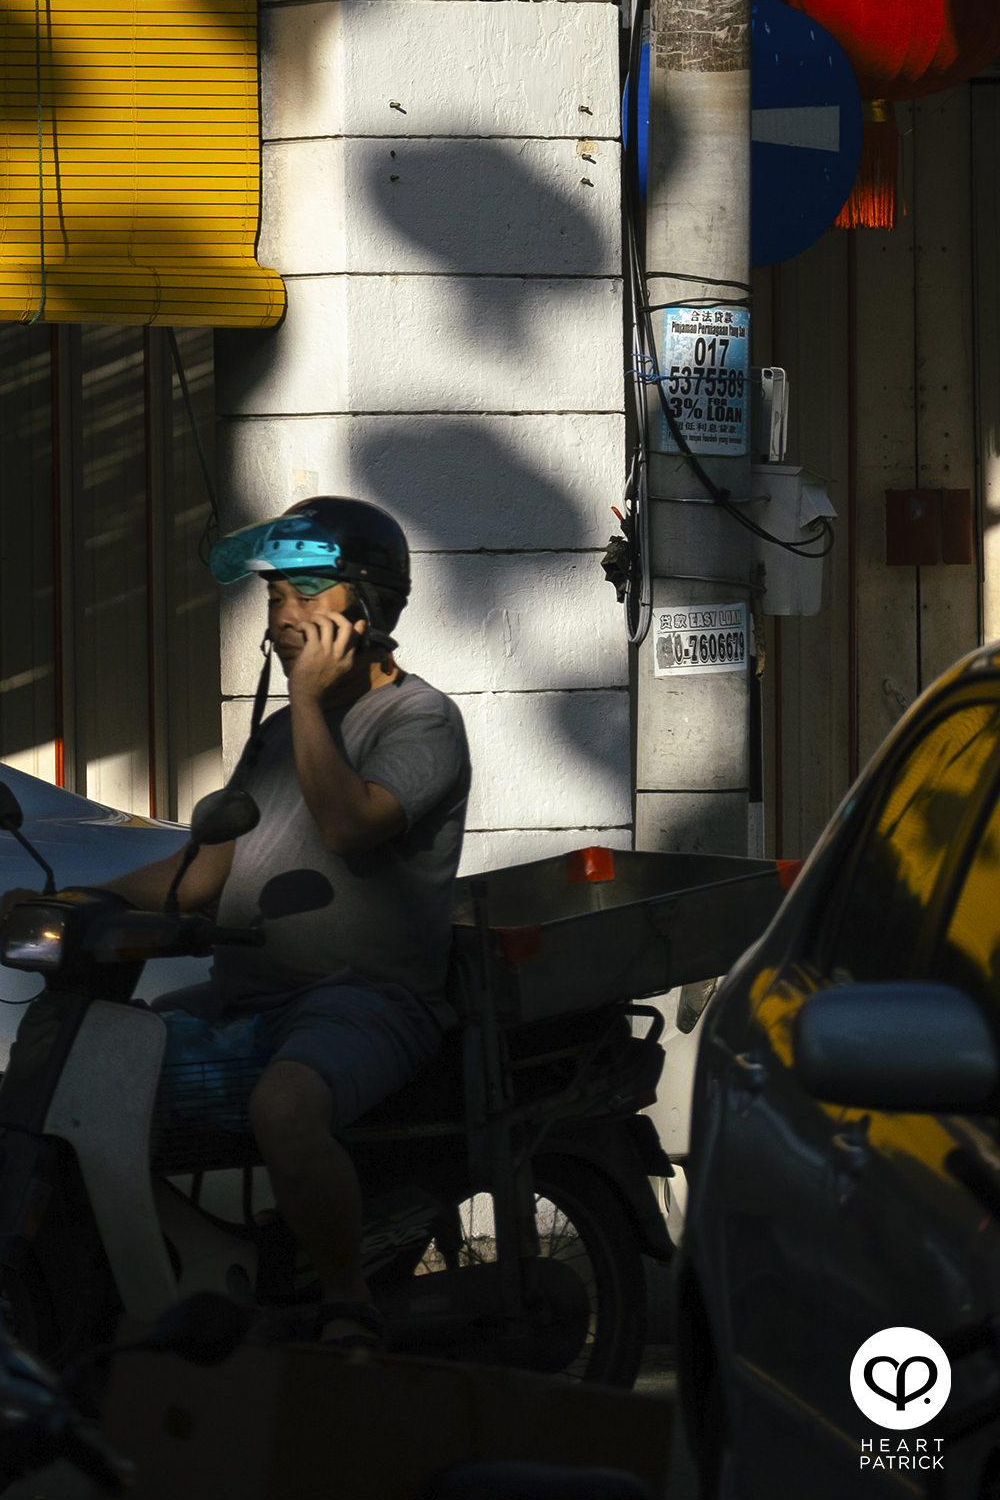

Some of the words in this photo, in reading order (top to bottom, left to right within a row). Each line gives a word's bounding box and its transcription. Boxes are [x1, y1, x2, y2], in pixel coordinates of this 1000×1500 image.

[694, 337, 730, 367] 017
[668, 366, 744, 398] 5375589
[669, 397, 703, 419] 3%
[708, 397, 727, 406] FOR
[707, 406, 742, 423] LOAN
[689, 611, 717, 628] EASY
[719, 609, 742, 626] LOAN
